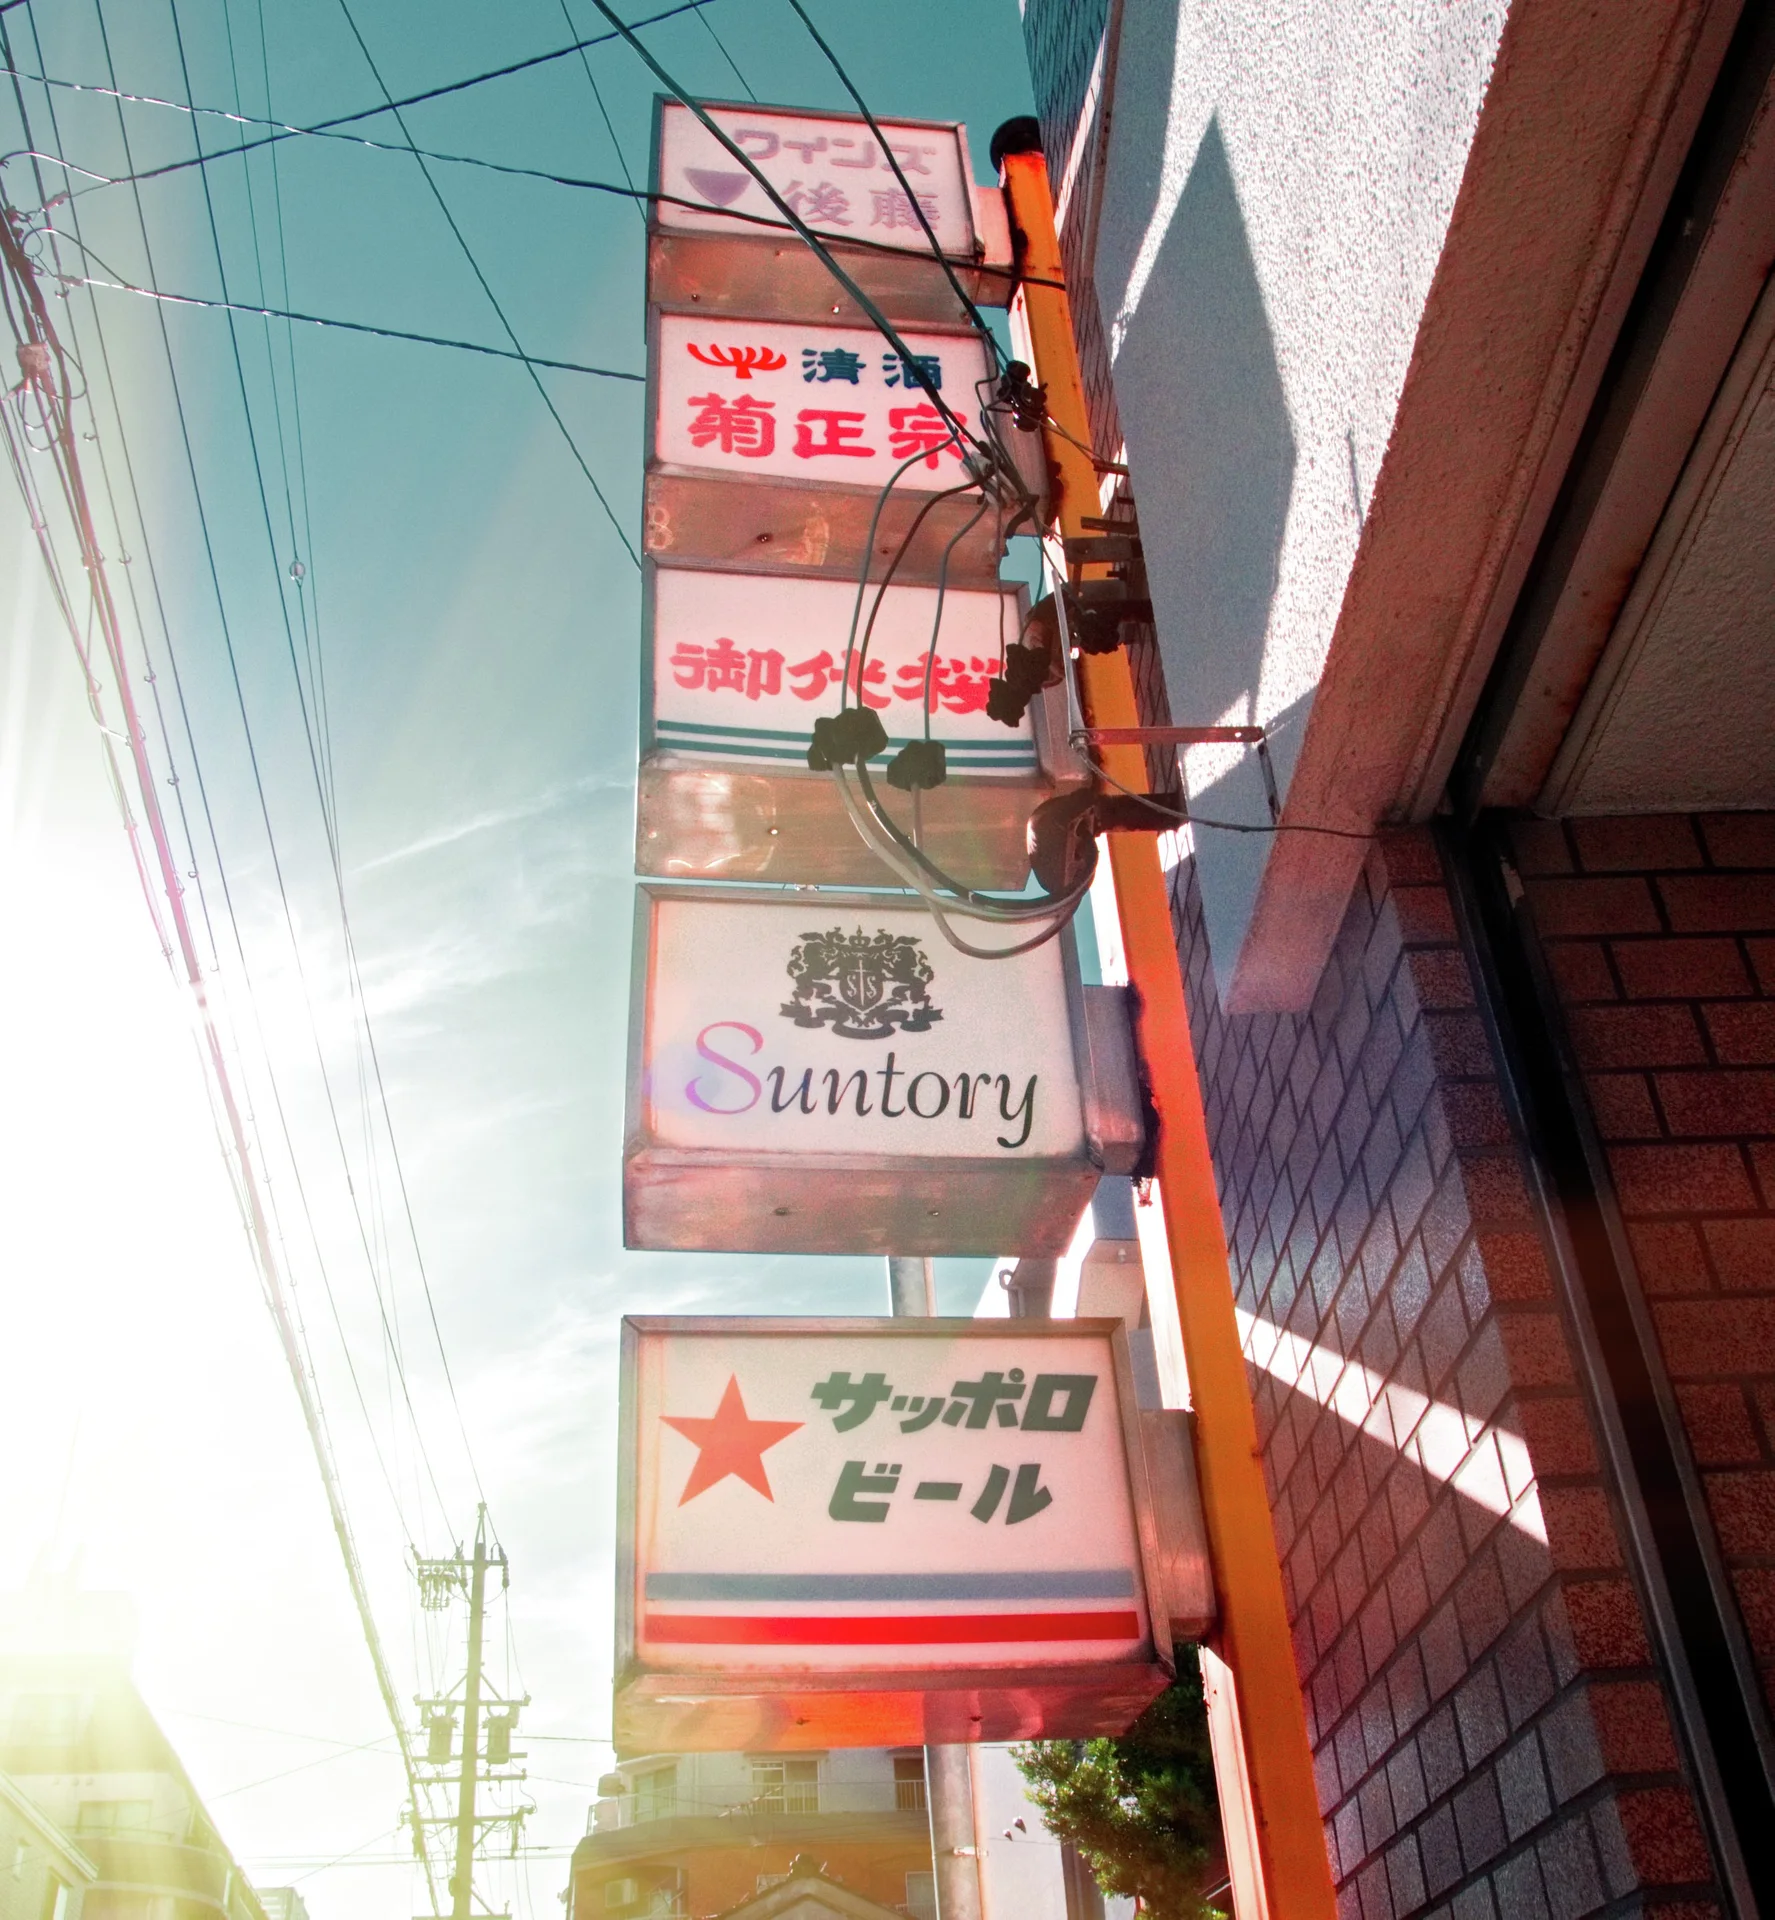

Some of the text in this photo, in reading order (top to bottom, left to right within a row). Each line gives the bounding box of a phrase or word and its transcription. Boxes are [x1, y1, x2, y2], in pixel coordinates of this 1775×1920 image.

[733, 128, 937, 175] ワインズ
[781, 179, 940, 232] 後藤
[801, 347, 942, 390] 清酒
[687, 392, 969, 470] 菊正宗
[685, 1020, 1038, 1149] Suntory
[810, 1367, 1099, 1434] サッポロ
[828, 1460, 1054, 1526] ビール
